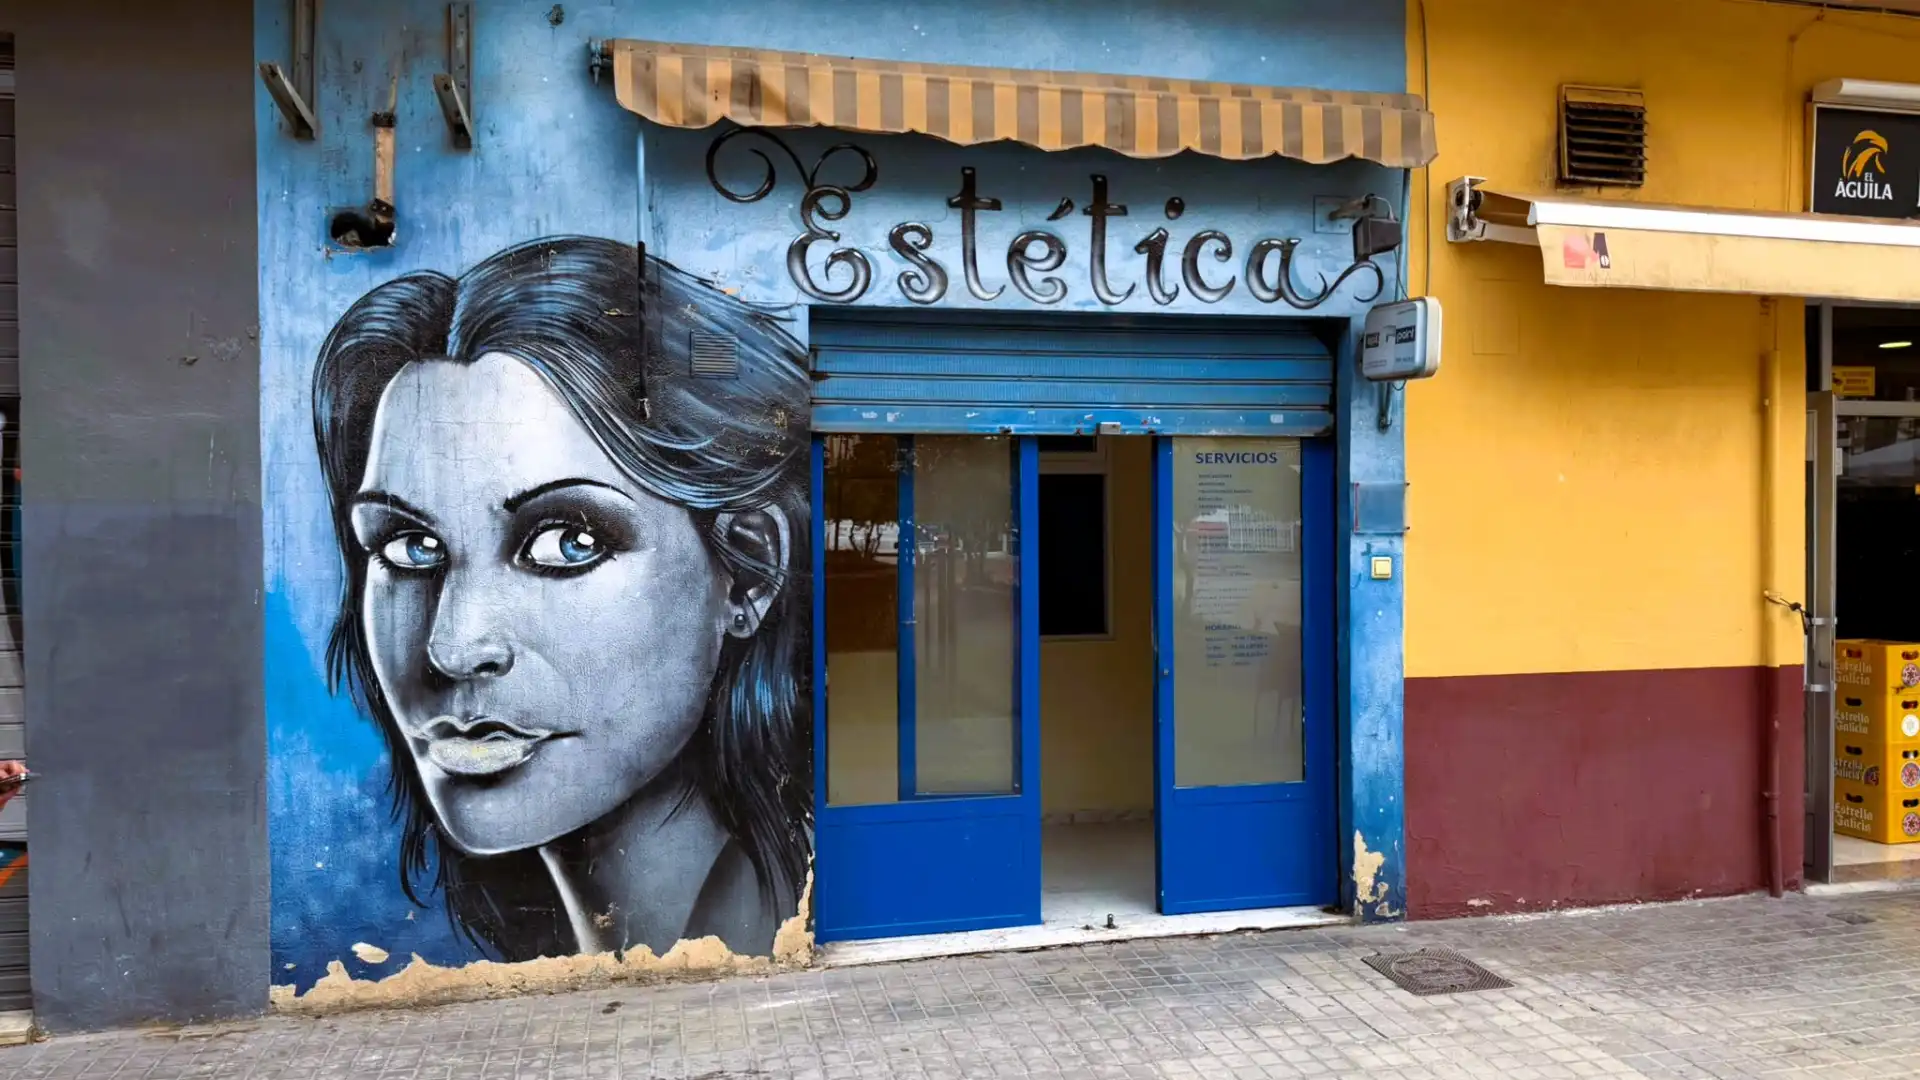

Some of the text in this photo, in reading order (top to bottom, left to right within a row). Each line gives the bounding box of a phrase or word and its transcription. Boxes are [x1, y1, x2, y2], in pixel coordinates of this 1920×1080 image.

[1863, 171, 1874, 182] EL
[705, 126, 1384, 309] Estética
[1195, 452, 1278, 464] SERVICIOS
[1834, 802, 1873, 821] Estrella
[1835, 814, 1872, 833] Galicia
